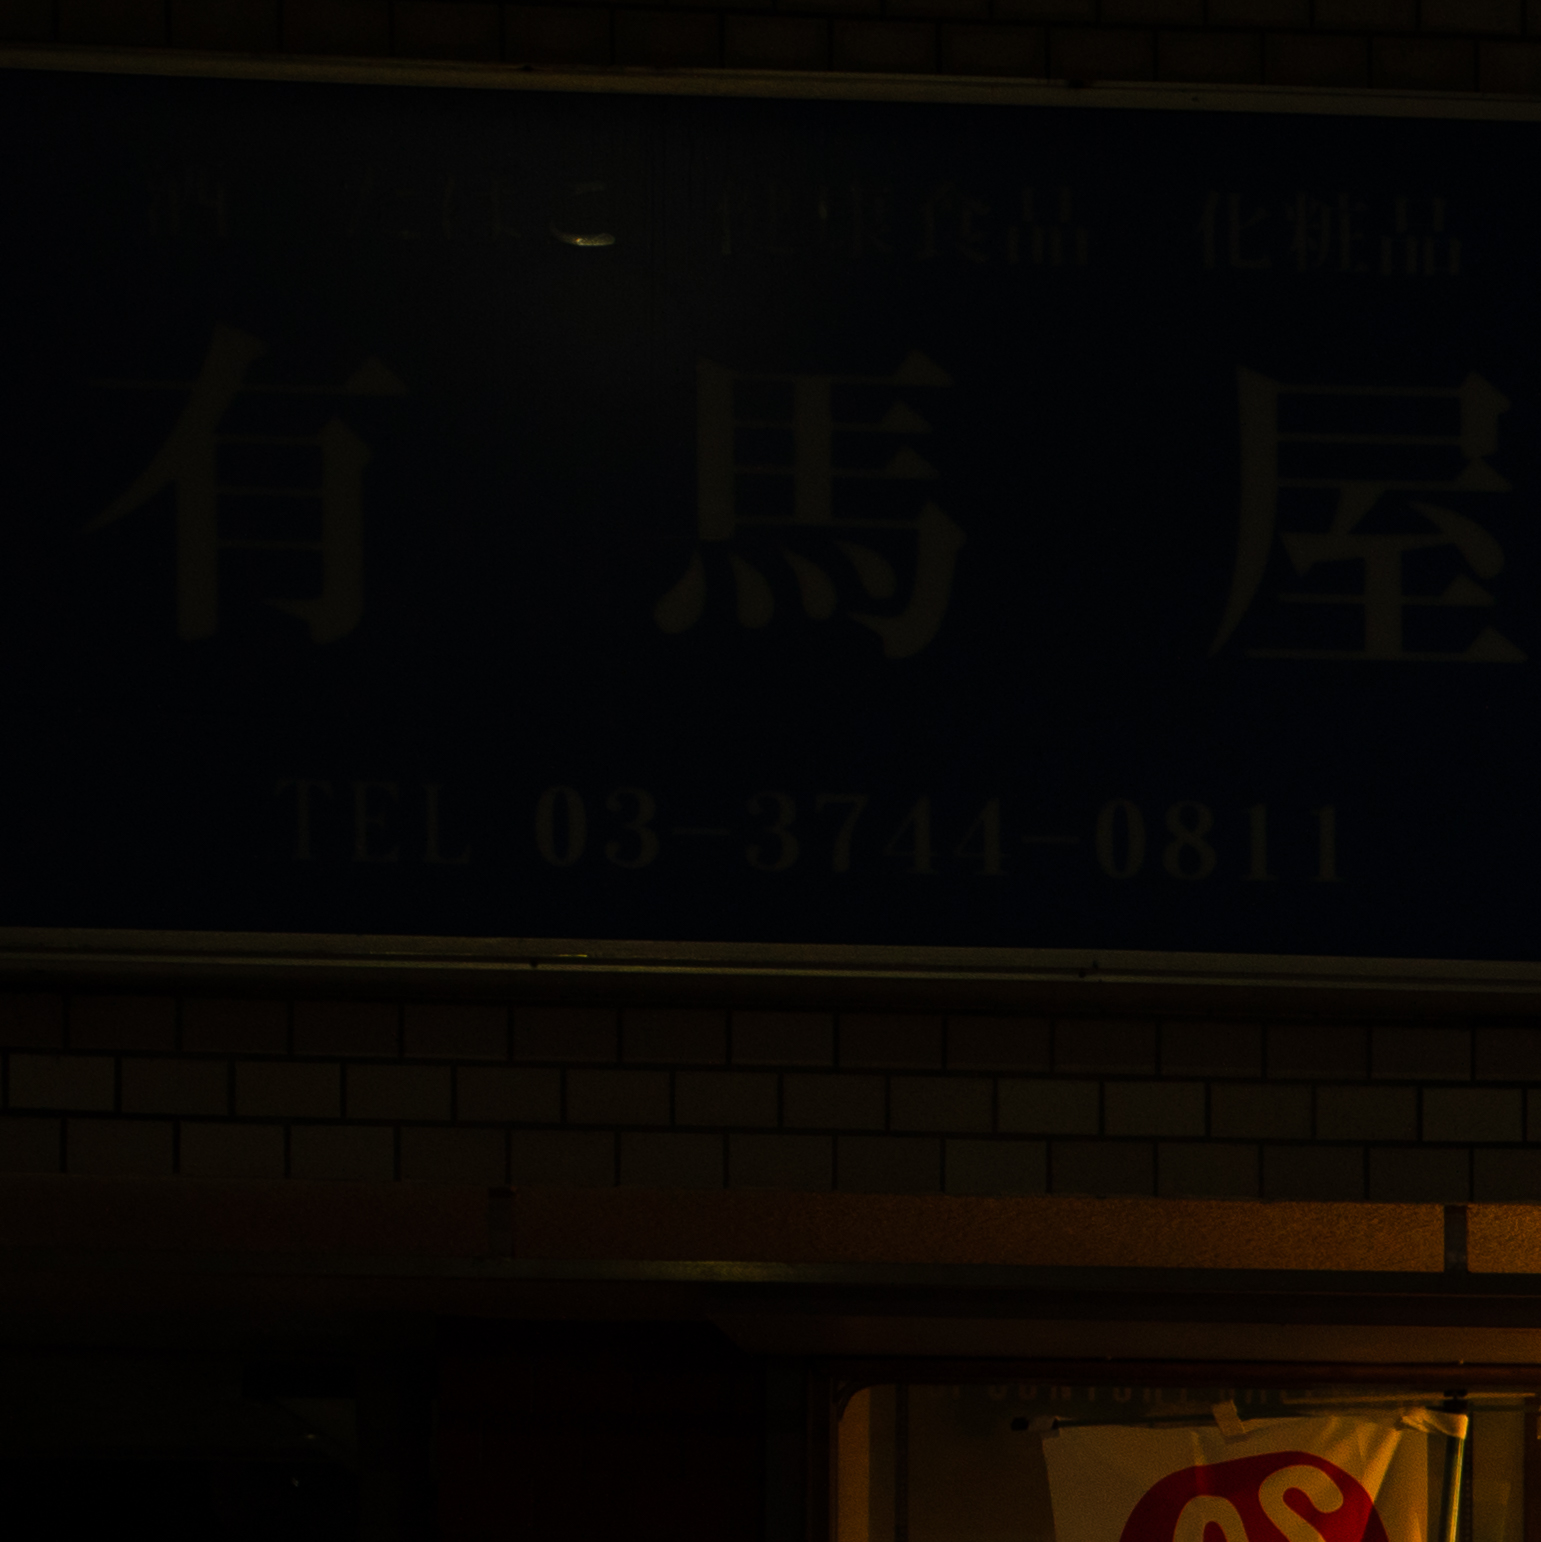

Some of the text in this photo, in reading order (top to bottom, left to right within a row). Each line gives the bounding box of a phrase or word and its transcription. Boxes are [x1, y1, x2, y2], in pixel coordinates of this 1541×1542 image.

[1195, 191, 1464, 278] 化粧品
[82, 321, 1527, 664] 有馬屋
[277, 780, 1346, 886] TEL 03-3744-0811
